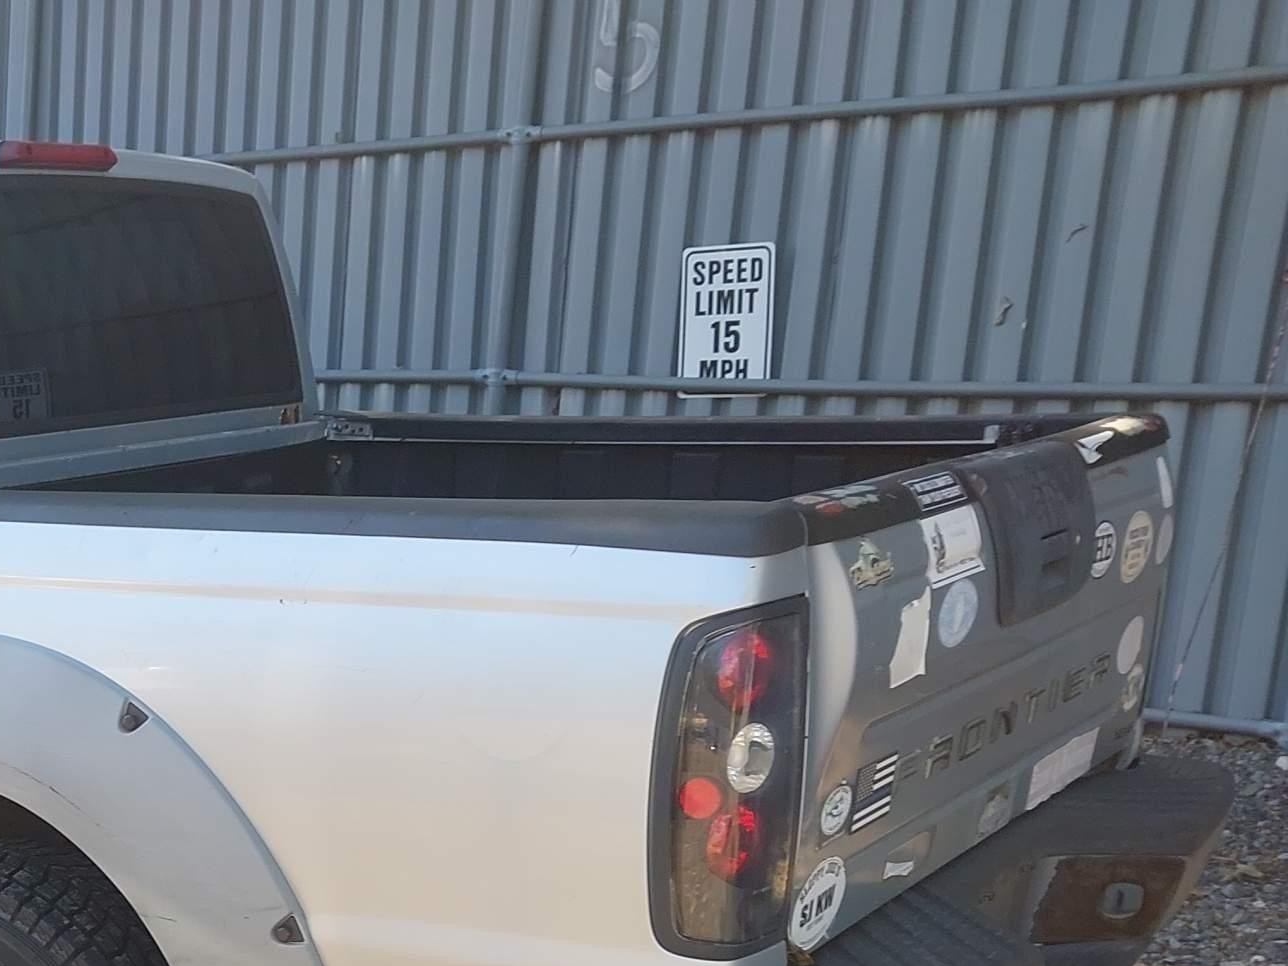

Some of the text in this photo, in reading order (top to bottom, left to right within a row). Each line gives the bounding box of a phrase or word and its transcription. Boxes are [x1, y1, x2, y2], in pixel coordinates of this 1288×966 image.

[692, 257, 764, 286] SPEED
[694, 288, 759, 316] LIMIT
[710, 320, 741, 353] 15
[699, 359, 749, 379] MPH
